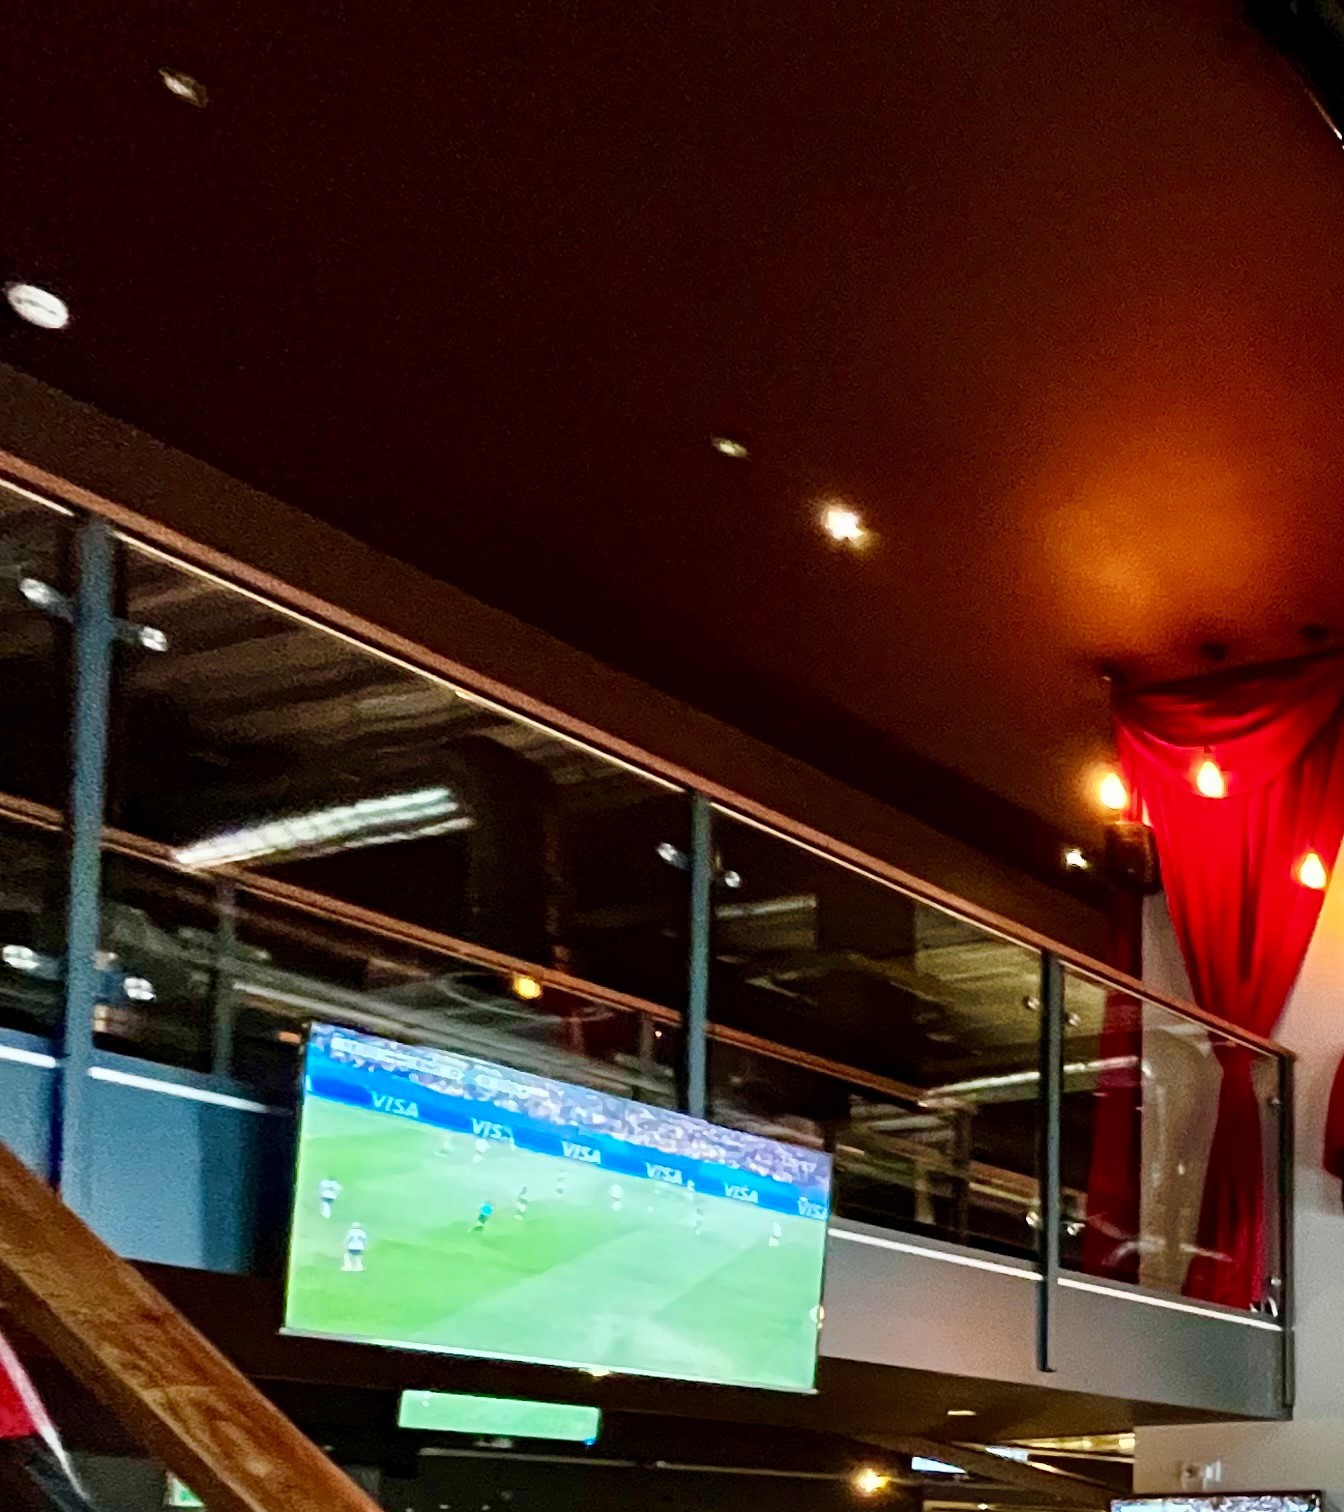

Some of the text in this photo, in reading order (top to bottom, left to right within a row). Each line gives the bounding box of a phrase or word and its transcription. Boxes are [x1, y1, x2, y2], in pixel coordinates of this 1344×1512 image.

[371, 1090, 419, 1118] VISA
[561, 1140, 601, 1165] VISA
[645, 1162, 683, 1185] VISA
[724, 1183, 759, 1204] VISA
